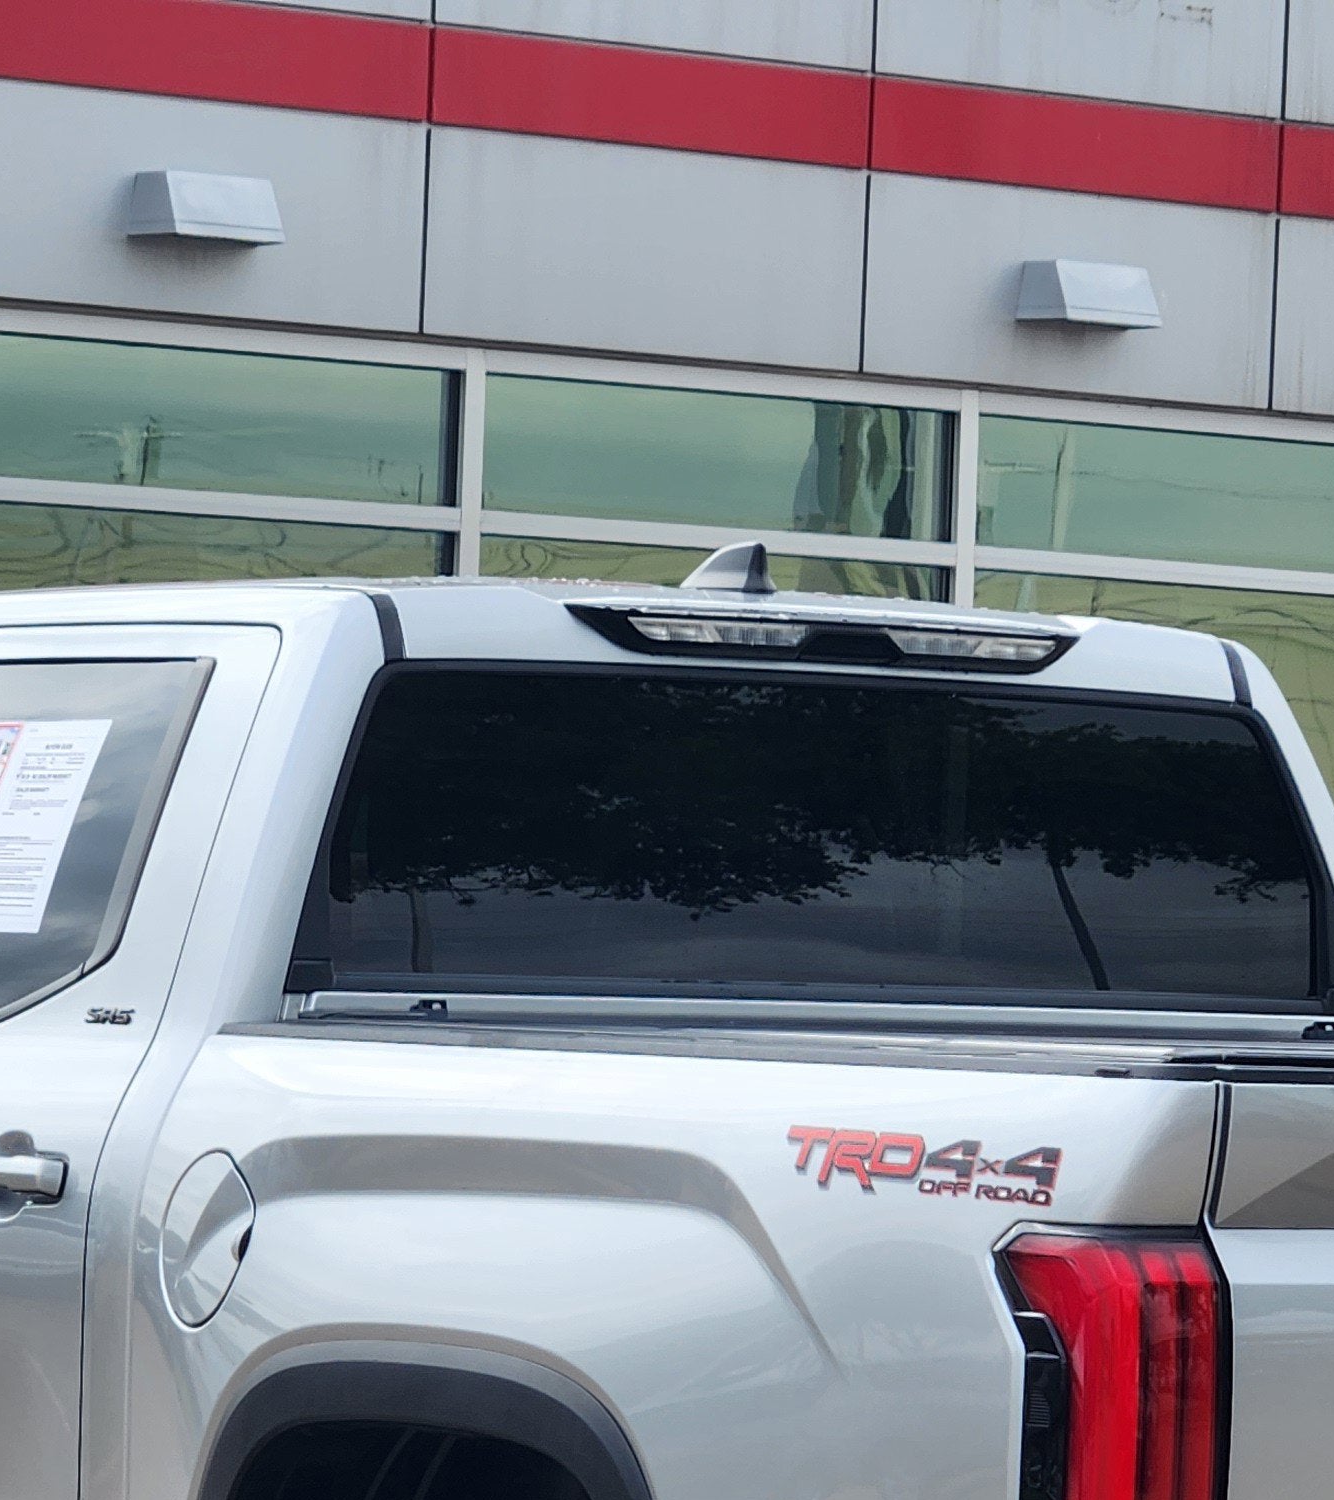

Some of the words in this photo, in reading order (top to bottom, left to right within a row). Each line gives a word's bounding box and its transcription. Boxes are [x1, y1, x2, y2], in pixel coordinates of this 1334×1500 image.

[787, 1124, 926, 1195] TRD
[917, 1178, 971, 1198] OFF
[974, 1183, 1053, 1206] ROAD
